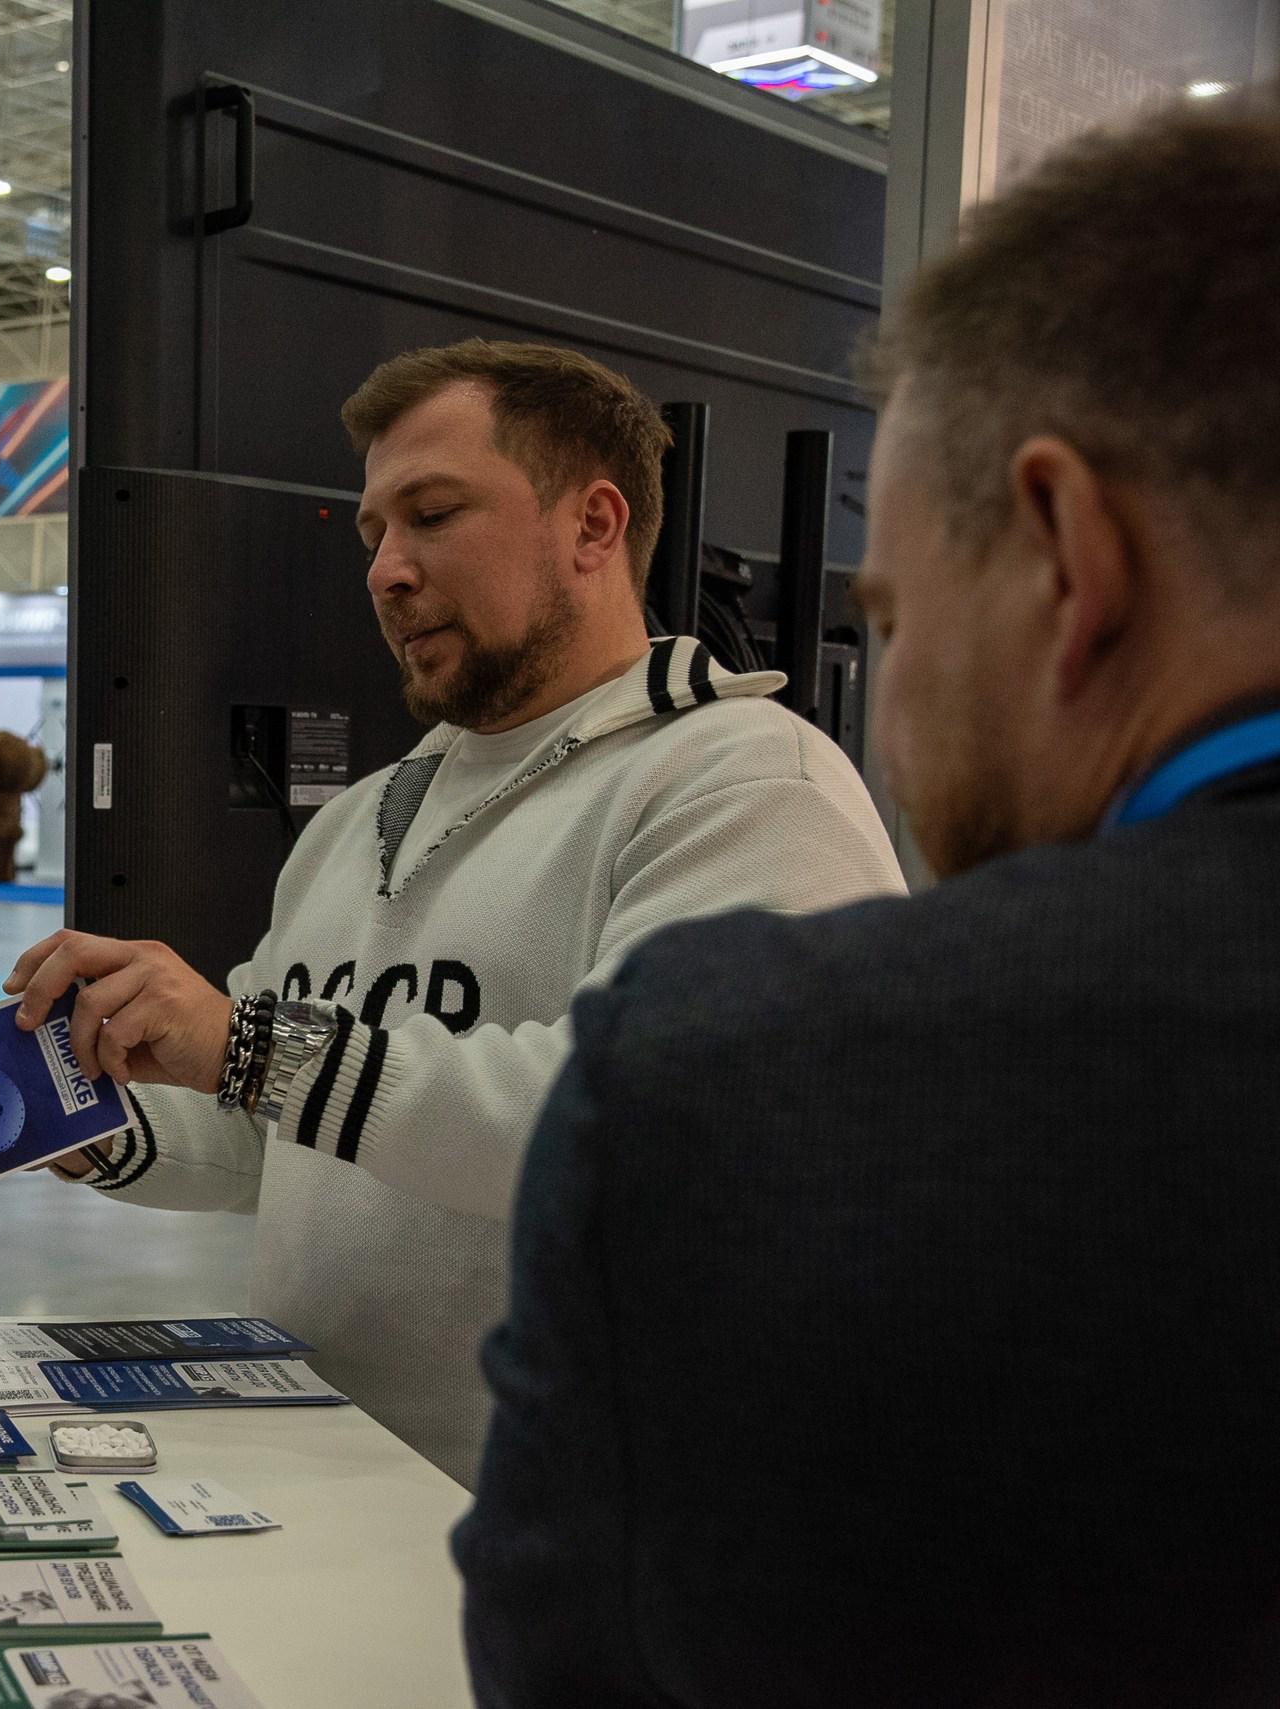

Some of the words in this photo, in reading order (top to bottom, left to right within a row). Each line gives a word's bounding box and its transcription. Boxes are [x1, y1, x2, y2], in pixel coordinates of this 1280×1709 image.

[48, 1019, 82, 1072] МИР
[69, 1073, 94, 1106] КБ
[60, 1089, 73, 1111] ЦЕНТР
[219, 1363, 241, 1381] ОРБИТЫ
[250, 1363, 267, 1372] ДЛЯ
[261, 1373, 290, 1392] КОСМОСА
[7, 1476, 46, 1516] ПРЕДЛОЖЕНИЕ
[28, 1476, 66, 1514] СПЕЦИАЛЬНОЕ
[52, 1563, 68, 1578] ДЛЯ
[60, 1578, 82, 1599] ВУЗОВ
[72, 1562, 111, 1611] ПРЕДЛОЖЕНИЕ
[94, 1562, 133, 1611] СПЕЦИАЛЬНОЕ
[133, 1646, 170, 1686] ОБРАЗЦА
[182, 1644, 203, 1656] ОТ
[192, 1657, 220, 1681] ИДЕИ
[155, 1645, 177, 1658] ДО
[166, 1659, 217, 1709] ЛЕТАЮЩЕГ
